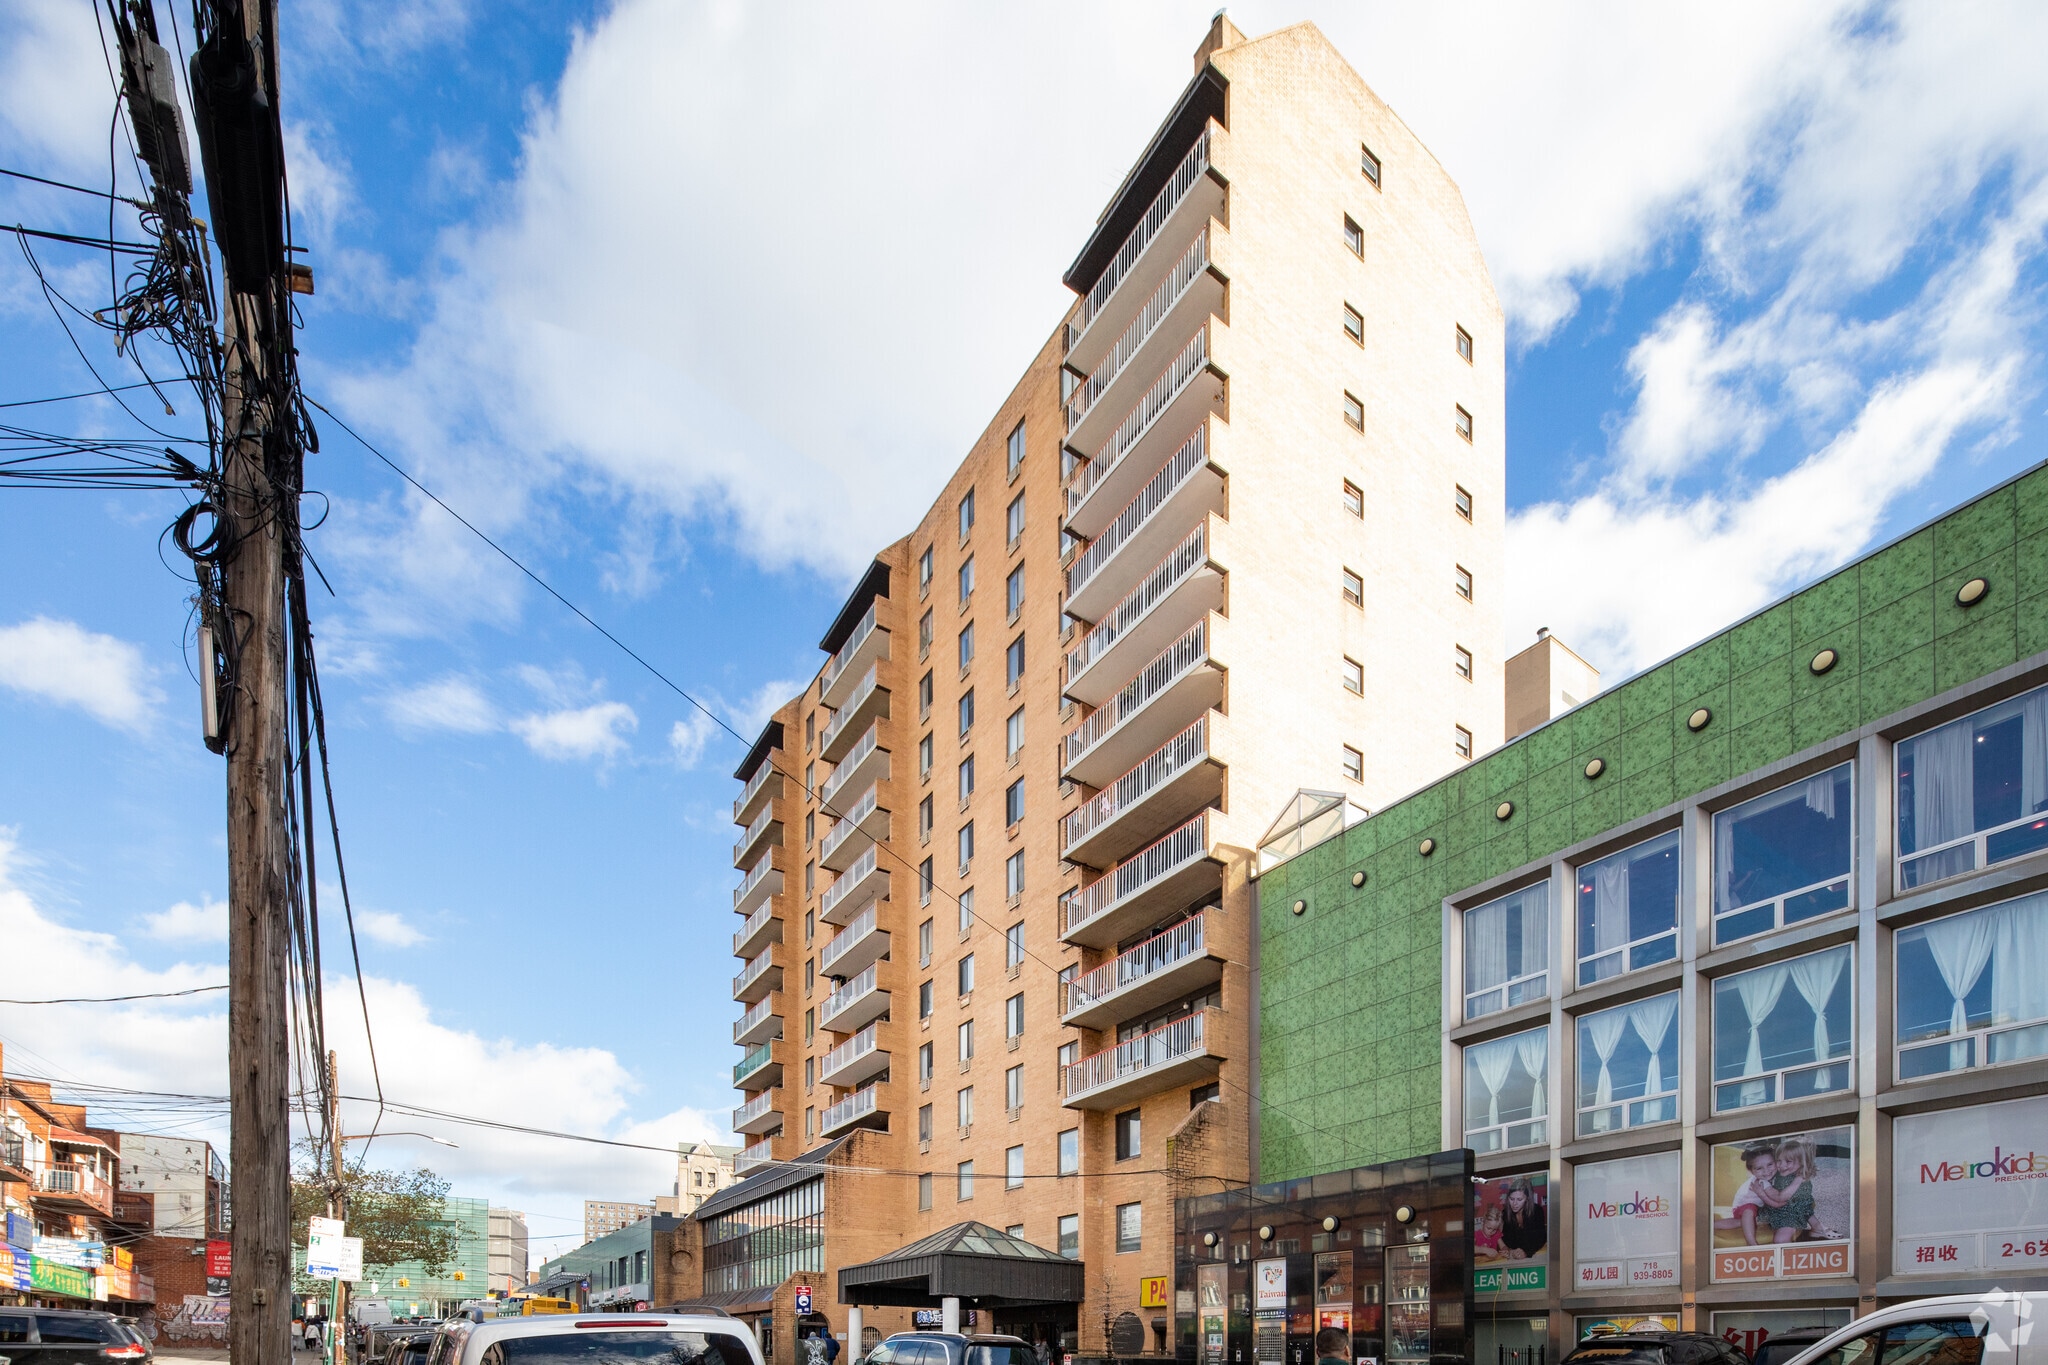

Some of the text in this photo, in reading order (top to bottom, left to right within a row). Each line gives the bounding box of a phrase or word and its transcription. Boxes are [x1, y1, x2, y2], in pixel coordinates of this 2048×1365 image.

[1920, 1146, 2048, 1184] Metrokids
[1994, 1172, 2048, 1183] PRESCHOOL
[1588, 1190, 1670, 1219] Metrokids
[1635, 1211, 1669, 1219] PRESCHOOL
[1916, 1244, 1958, 1263] 招收
[1643, 1261, 1658, 1270] 718
[1723, 1251, 1843, 1273] SOCIALIZING
[1582, 1266, 1619, 1281] 幼儿园
[1633, 1269, 1673, 1280] 939-8805
[1259, 1290, 1286, 1299] Taiwan
